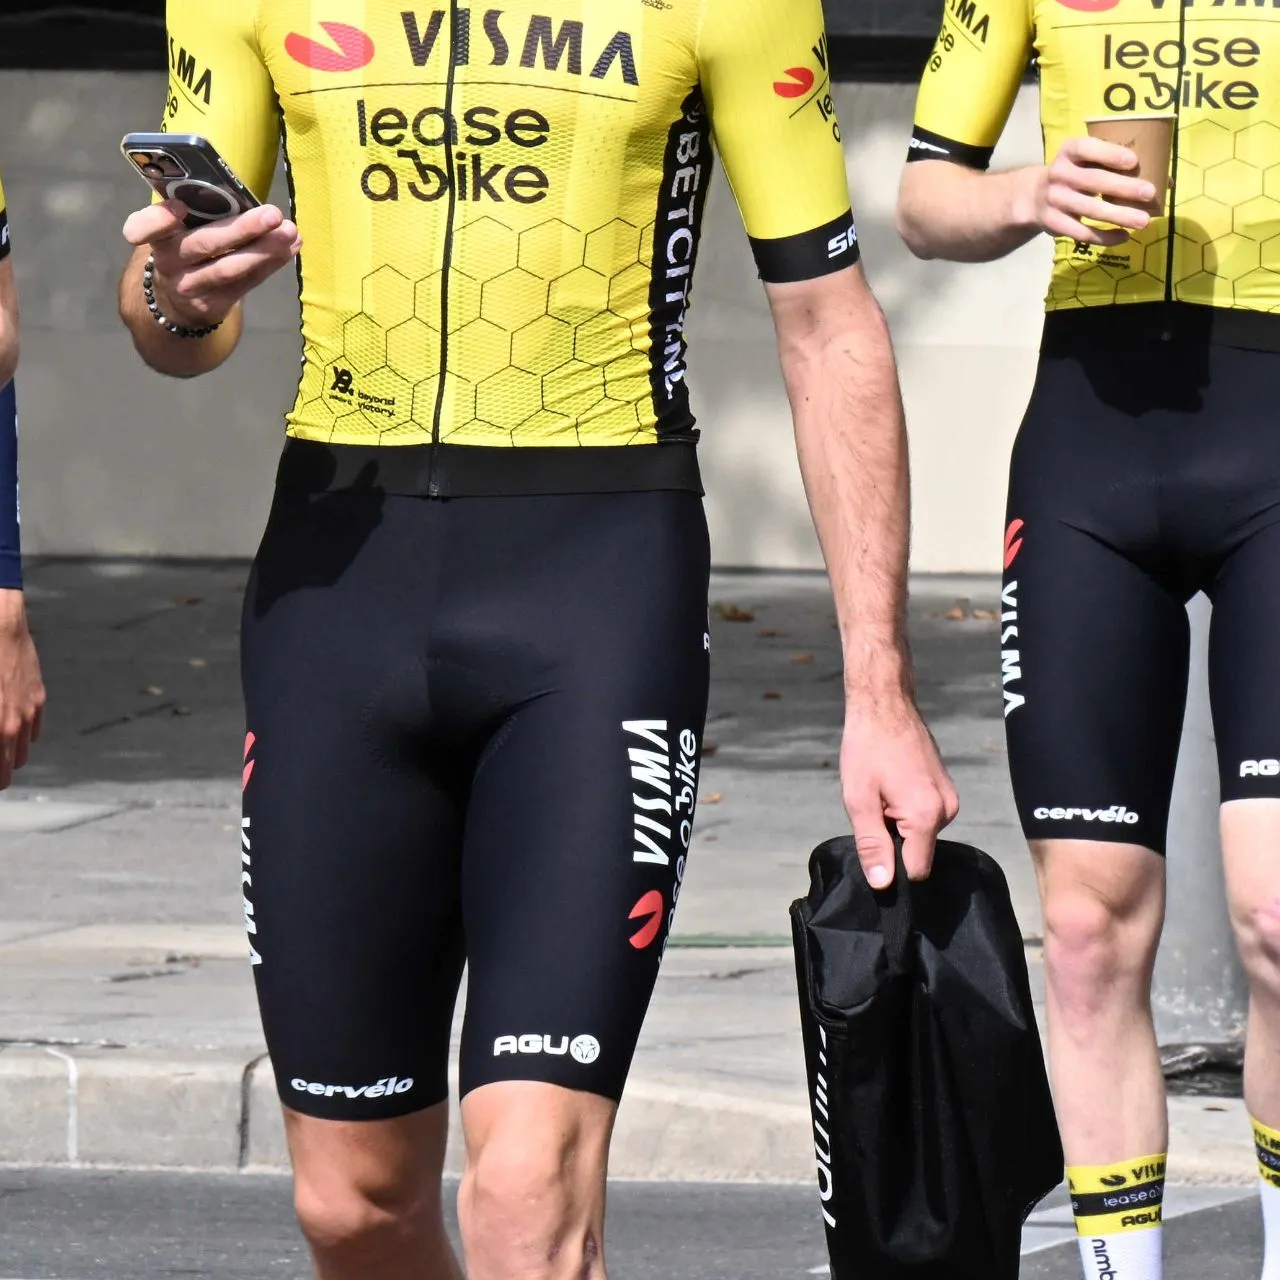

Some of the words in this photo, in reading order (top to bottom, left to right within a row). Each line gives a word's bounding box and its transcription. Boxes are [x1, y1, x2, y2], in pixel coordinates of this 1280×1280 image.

[400, 7, 639, 87] VISMA
[1103, 34, 1261, 70] lease
[357, 99, 551, 147] lease
[1001, 580, 1026, 719] VISMA
[621, 719, 672, 867] VISMA
[1033, 805, 1139, 824] cervélo
[493, 1033, 570, 1057] AGU
[290, 1075, 415, 1099] cervélo
[1103, 1191, 1148, 1208] lease
